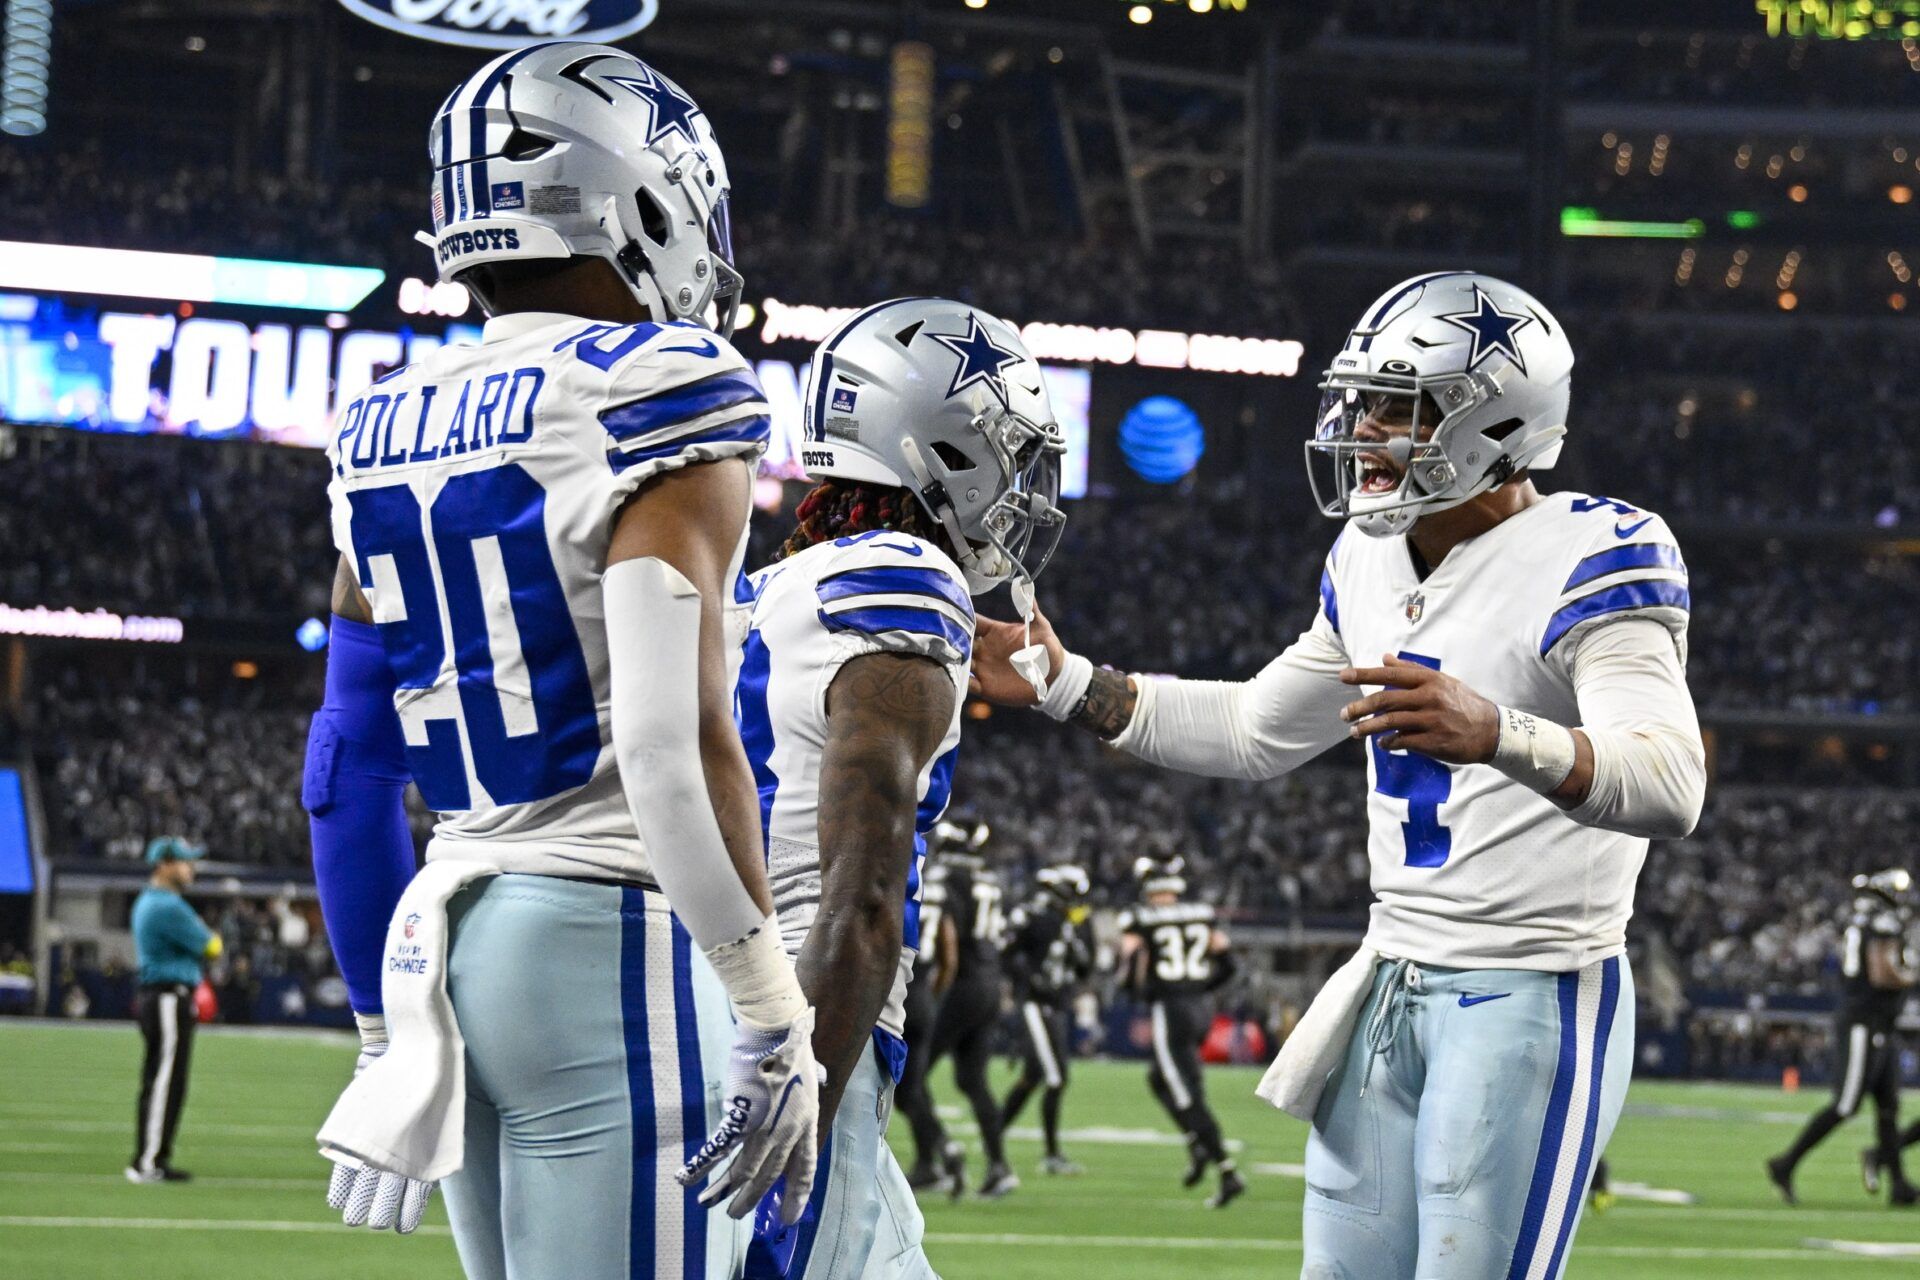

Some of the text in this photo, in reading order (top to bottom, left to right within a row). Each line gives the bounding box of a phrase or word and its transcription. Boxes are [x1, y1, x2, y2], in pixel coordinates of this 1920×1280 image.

[438, 228, 520, 264] COWBOYS
[100, 311, 440, 432] TOUC
[336, 367, 546, 476] POLLARD
[346, 463, 601, 811] 20
[1154, 924, 1210, 981] 32
